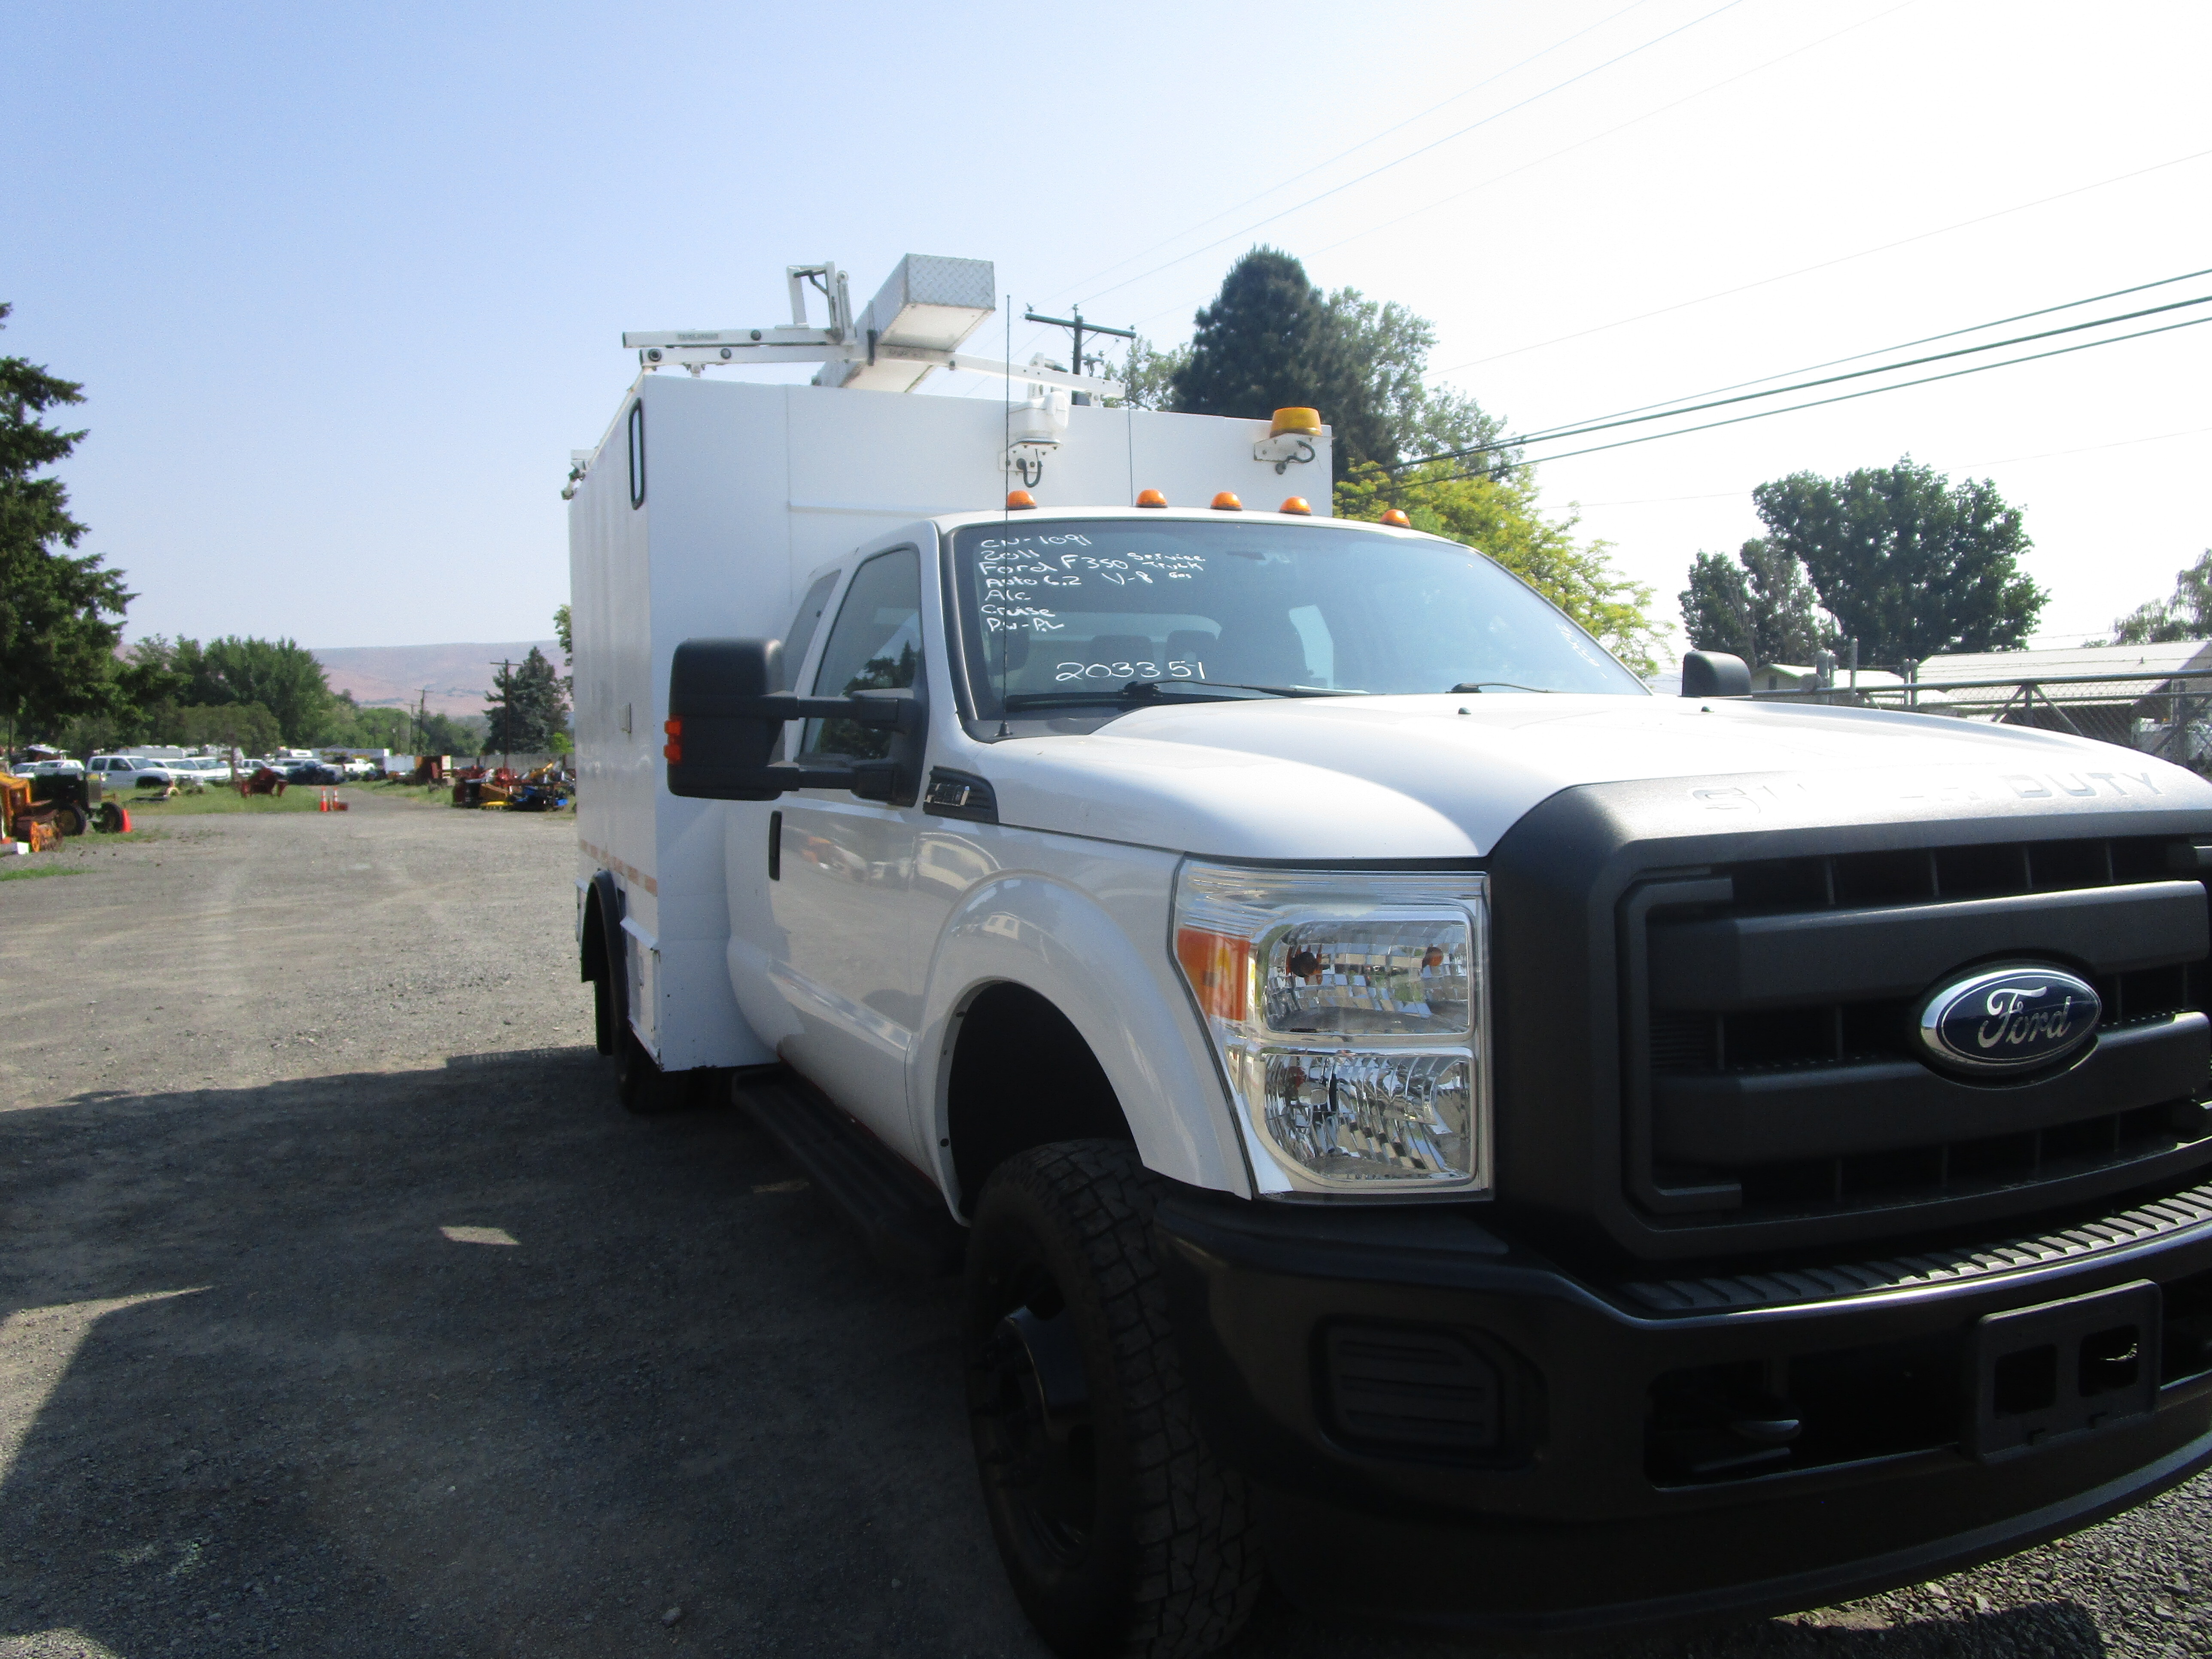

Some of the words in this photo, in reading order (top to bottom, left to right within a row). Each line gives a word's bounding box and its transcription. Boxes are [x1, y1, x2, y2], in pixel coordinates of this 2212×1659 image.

[981, 549, 1040, 561] 2011
[978, 562, 1058, 575] Ford
[986, 576, 1038, 588] Auto
[1044, 575, 1082, 586] 6.2
[981, 604, 1056, 617] Cruise
[1999, 772, 2166, 799] DUTY
[1978, 986, 2072, 1048] Ford
